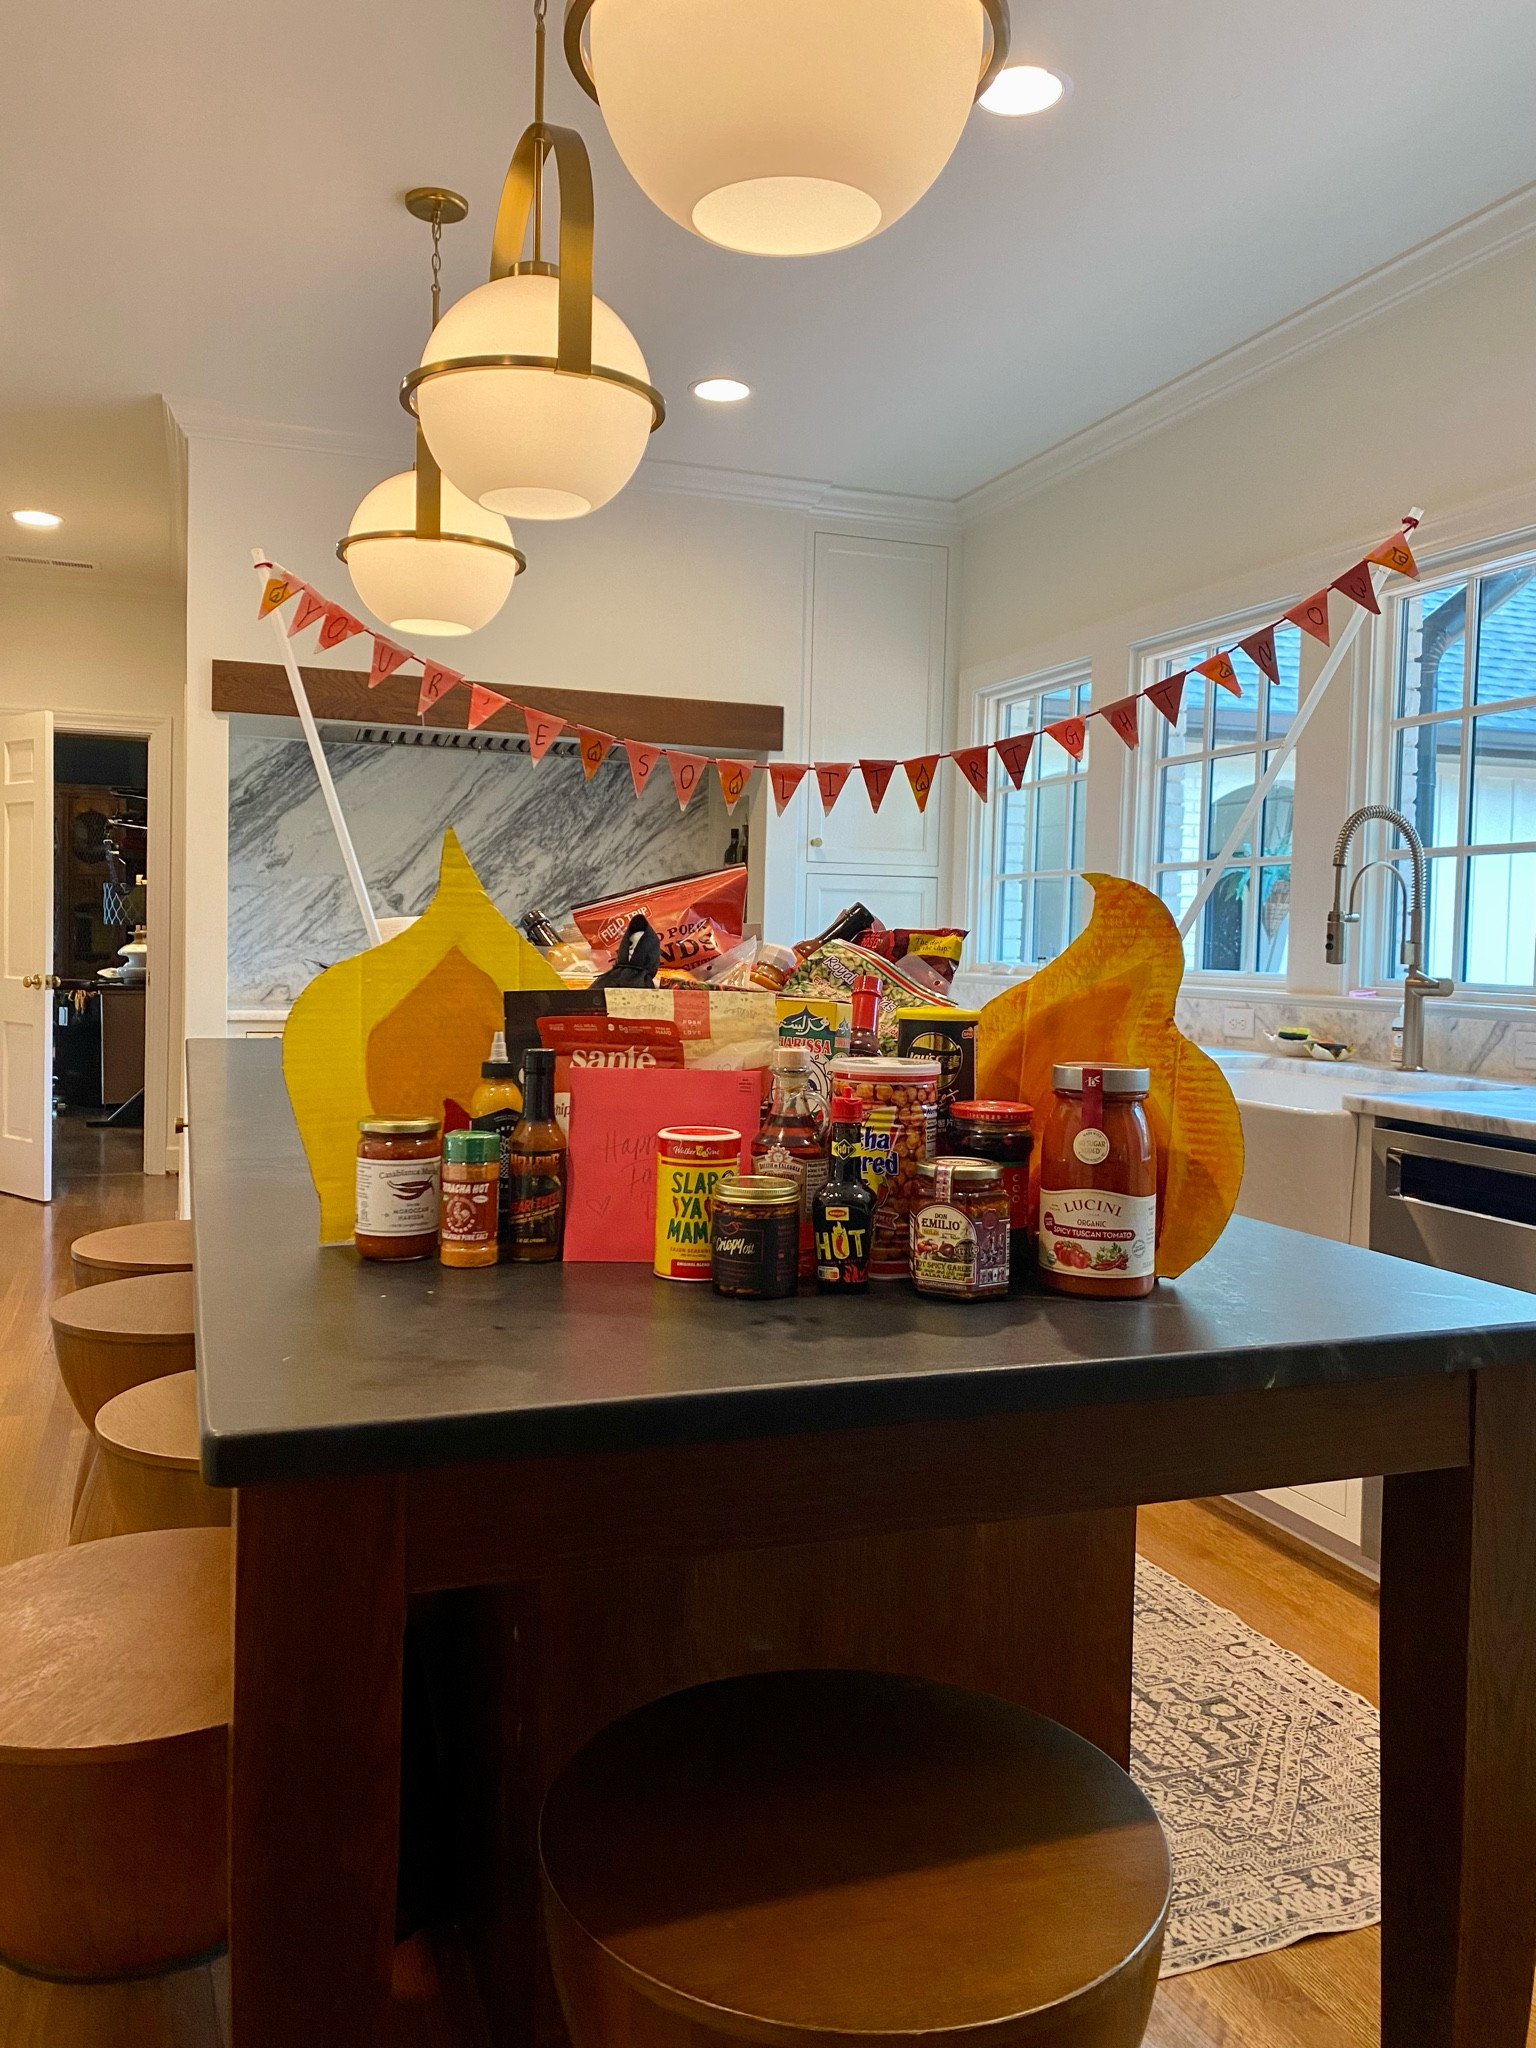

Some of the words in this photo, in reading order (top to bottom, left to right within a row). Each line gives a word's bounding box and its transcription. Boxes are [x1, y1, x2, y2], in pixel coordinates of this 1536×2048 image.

[779, 766, 888, 801] LIT
[968, 684, 1175, 783] RIGHT
[1259, 576, 1369, 667] NOW
[600, 917, 626, 943] FIELD
[915, 937, 928, 945] The
[823, 955, 858, 985] Royal
[778, 1035, 832, 1056] HARISSA
[568, 1045, 658, 1069] santé
[472, 1183, 490, 1194] HOT
[671, 1171, 719, 1195] SLAP
[681, 1196, 703, 1220] YA
[934, 1212, 948, 1220] DON
[1064, 1198, 1122, 1217] LUCINI
[666, 1218, 713, 1245] MAM
[921, 1217, 960, 1231] EMILIO
[1053, 1225, 1072, 1235] SPICY
[1072, 1230, 1101, 1238] TUSCAN
[1103, 1231, 1133, 1239] TOMATO
[1076, 1218, 1107, 1228] ORGANIC
[815, 1226, 866, 1260] HOT
[927, 1261, 946, 1270] SPICY
